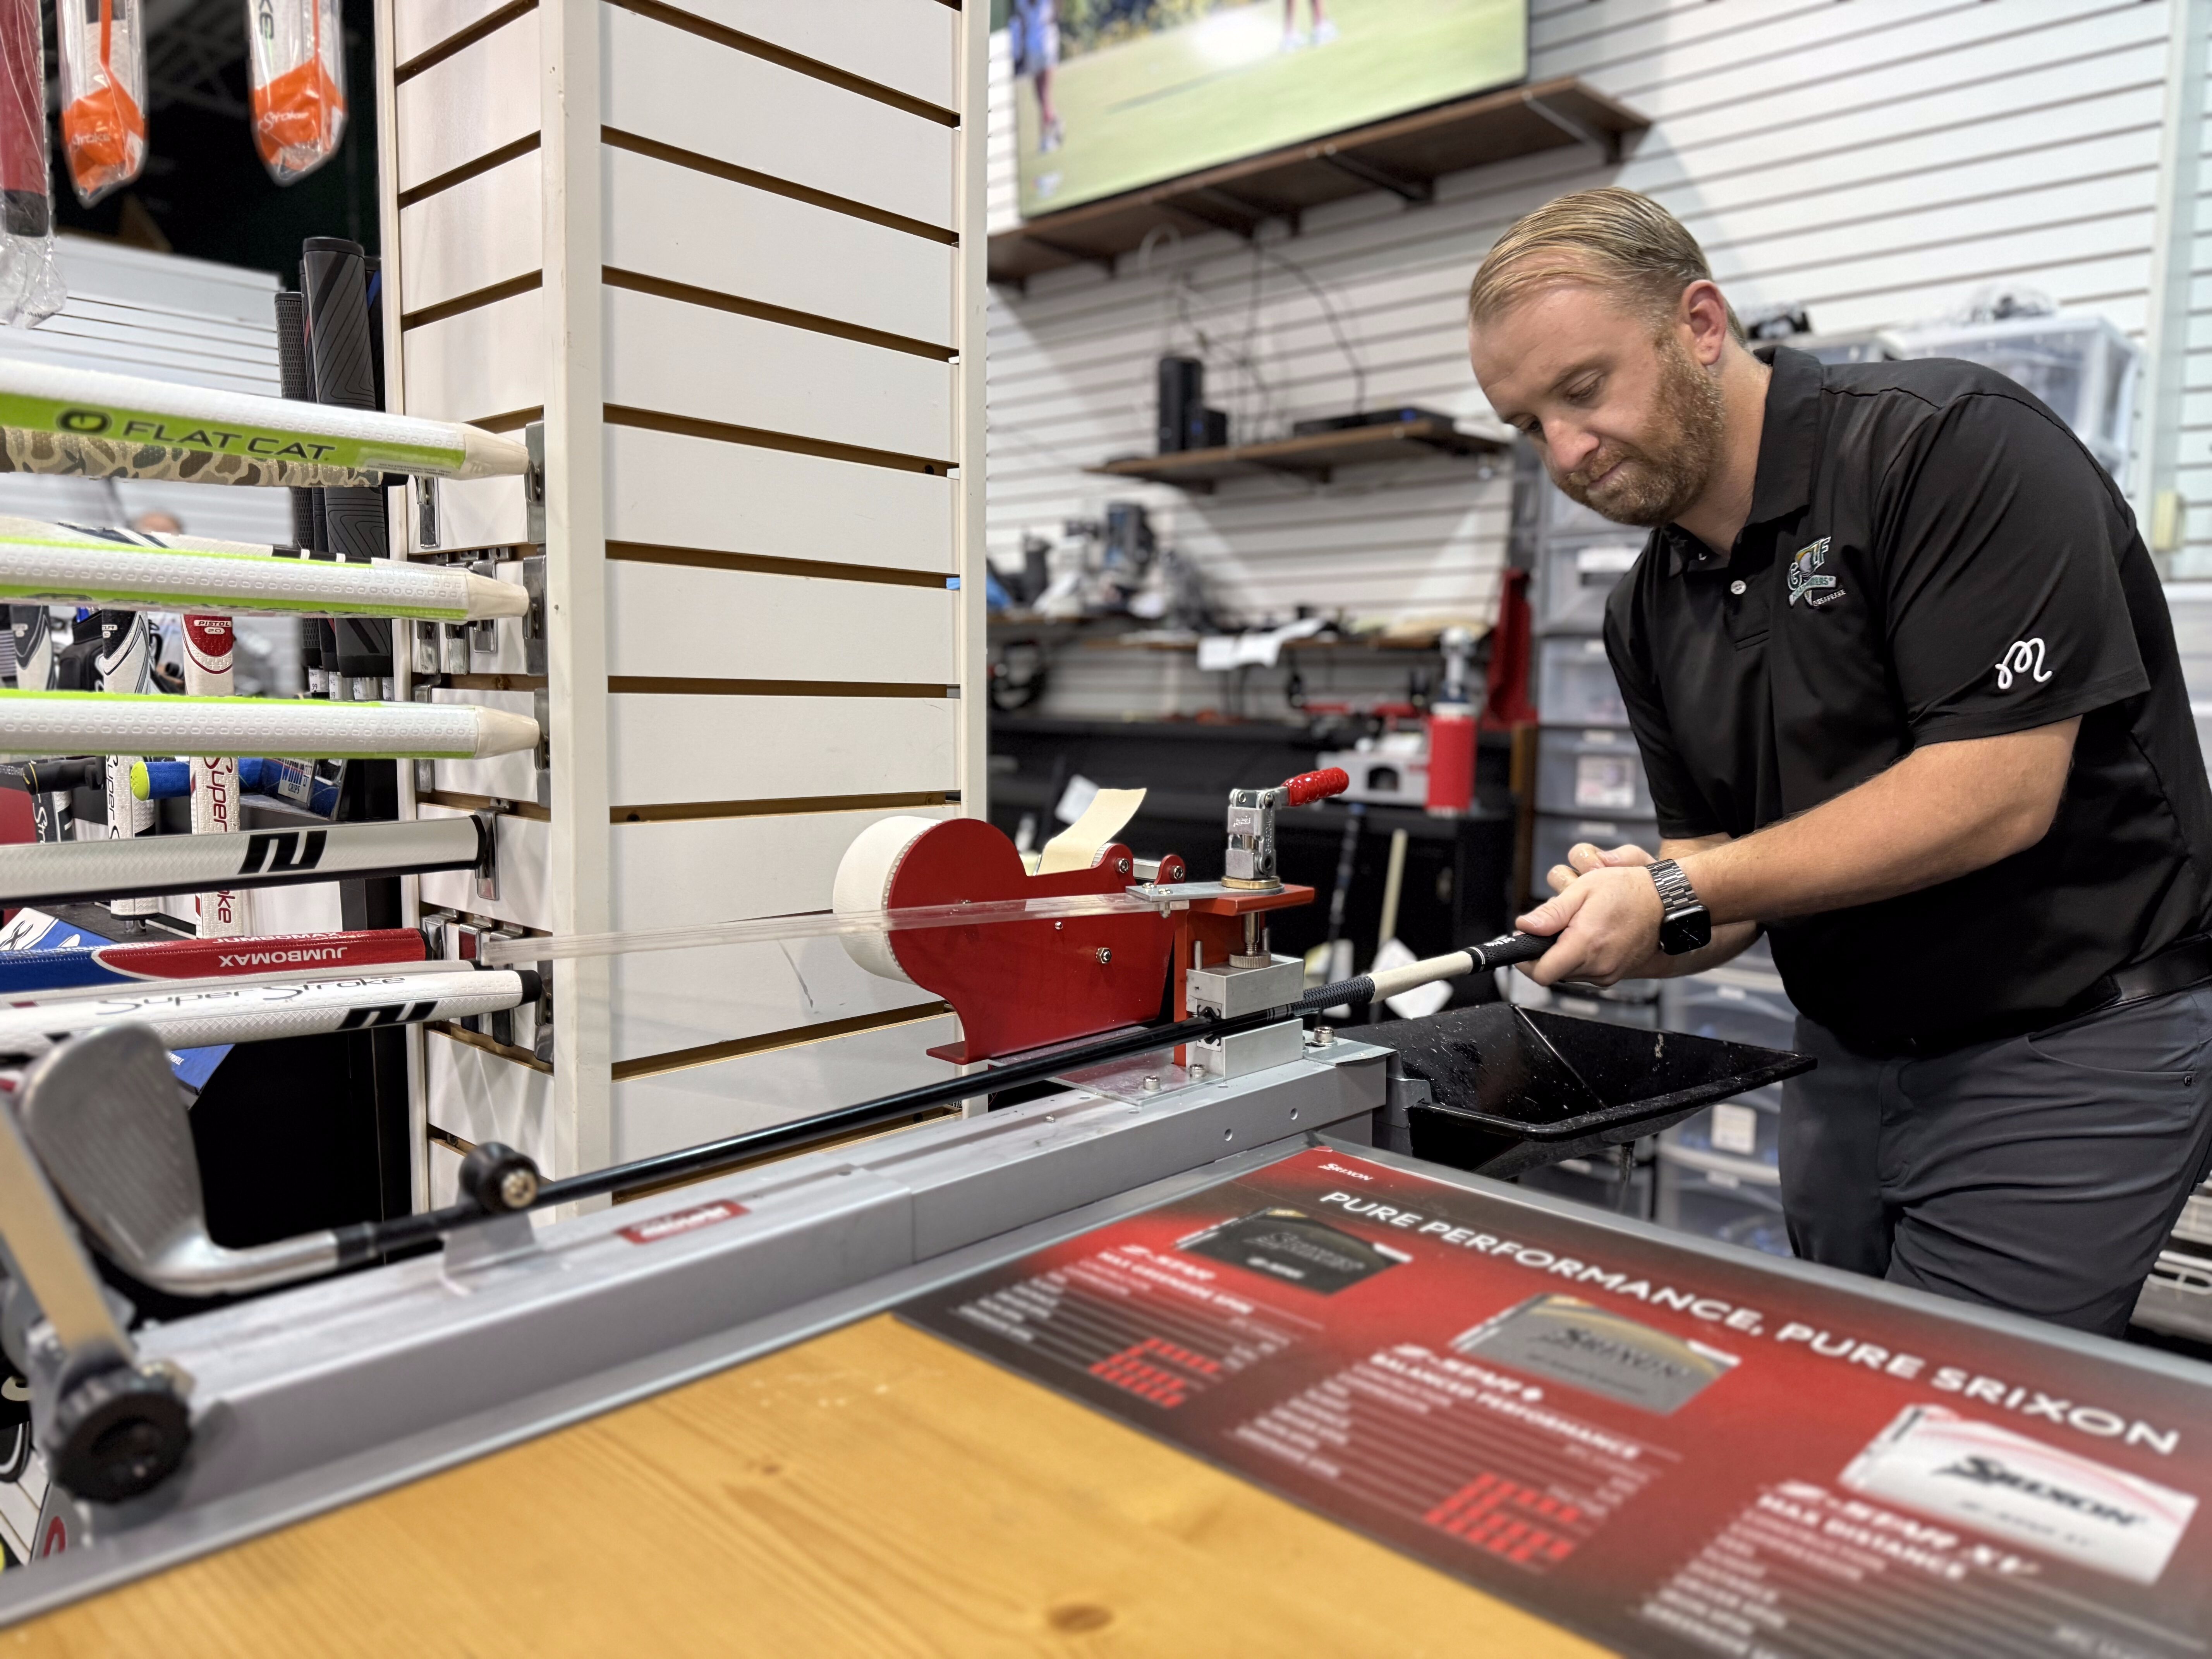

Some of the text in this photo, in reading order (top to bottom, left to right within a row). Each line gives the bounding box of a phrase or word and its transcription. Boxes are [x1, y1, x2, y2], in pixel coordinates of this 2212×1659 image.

[123, 420, 335, 461] FLAT CAT
[212, 932, 341, 944] JUMBOMAX
[219, 947, 348, 967] JUMBOMAX
[1318, 1163, 1374, 1181] SRIXON
[1319, 1191, 2181, 1455] PURE PERFORMANCE, PURE SRIXON
[1931, 1455, 2147, 1527] SRIXON
